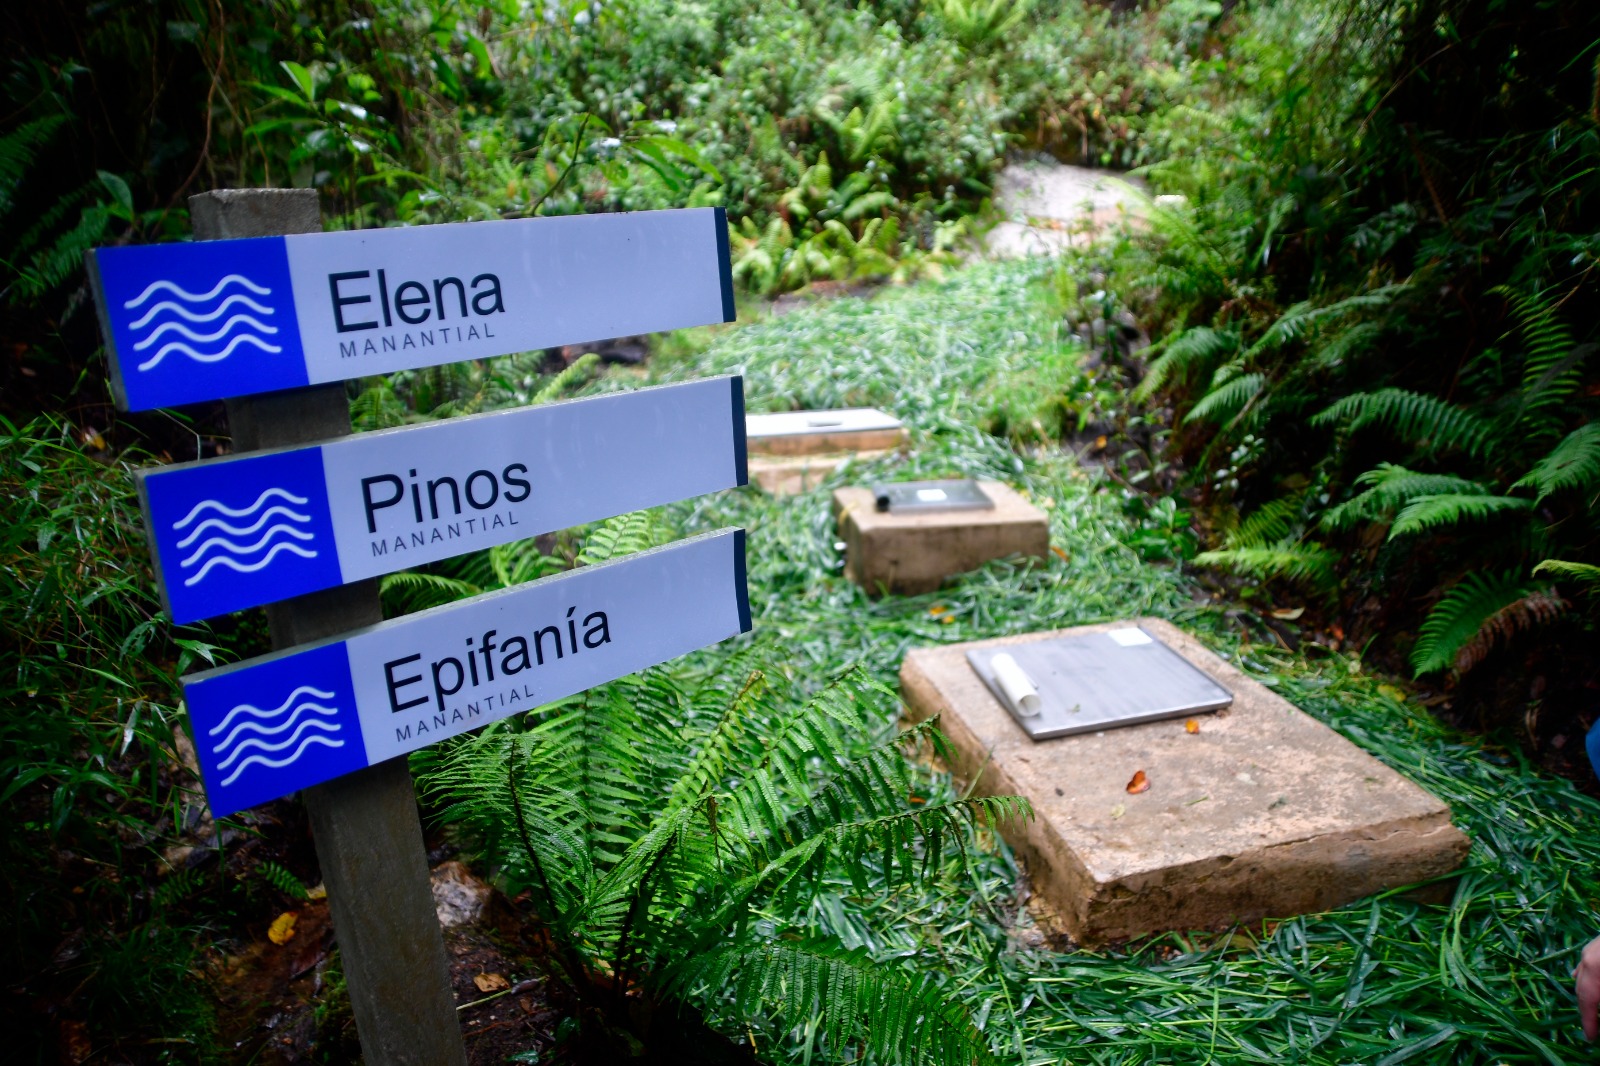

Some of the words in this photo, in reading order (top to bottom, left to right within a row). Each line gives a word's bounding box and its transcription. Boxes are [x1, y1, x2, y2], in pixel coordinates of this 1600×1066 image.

[328, 269, 505, 333] Elena
[340, 322, 495, 358] MANANTIAL
[361, 463, 531, 533] Pinos
[372, 511, 520, 557] MANANTIAL
[383, 606, 611, 713] Epifanía
[396, 684, 535, 742] MANANTIAL
